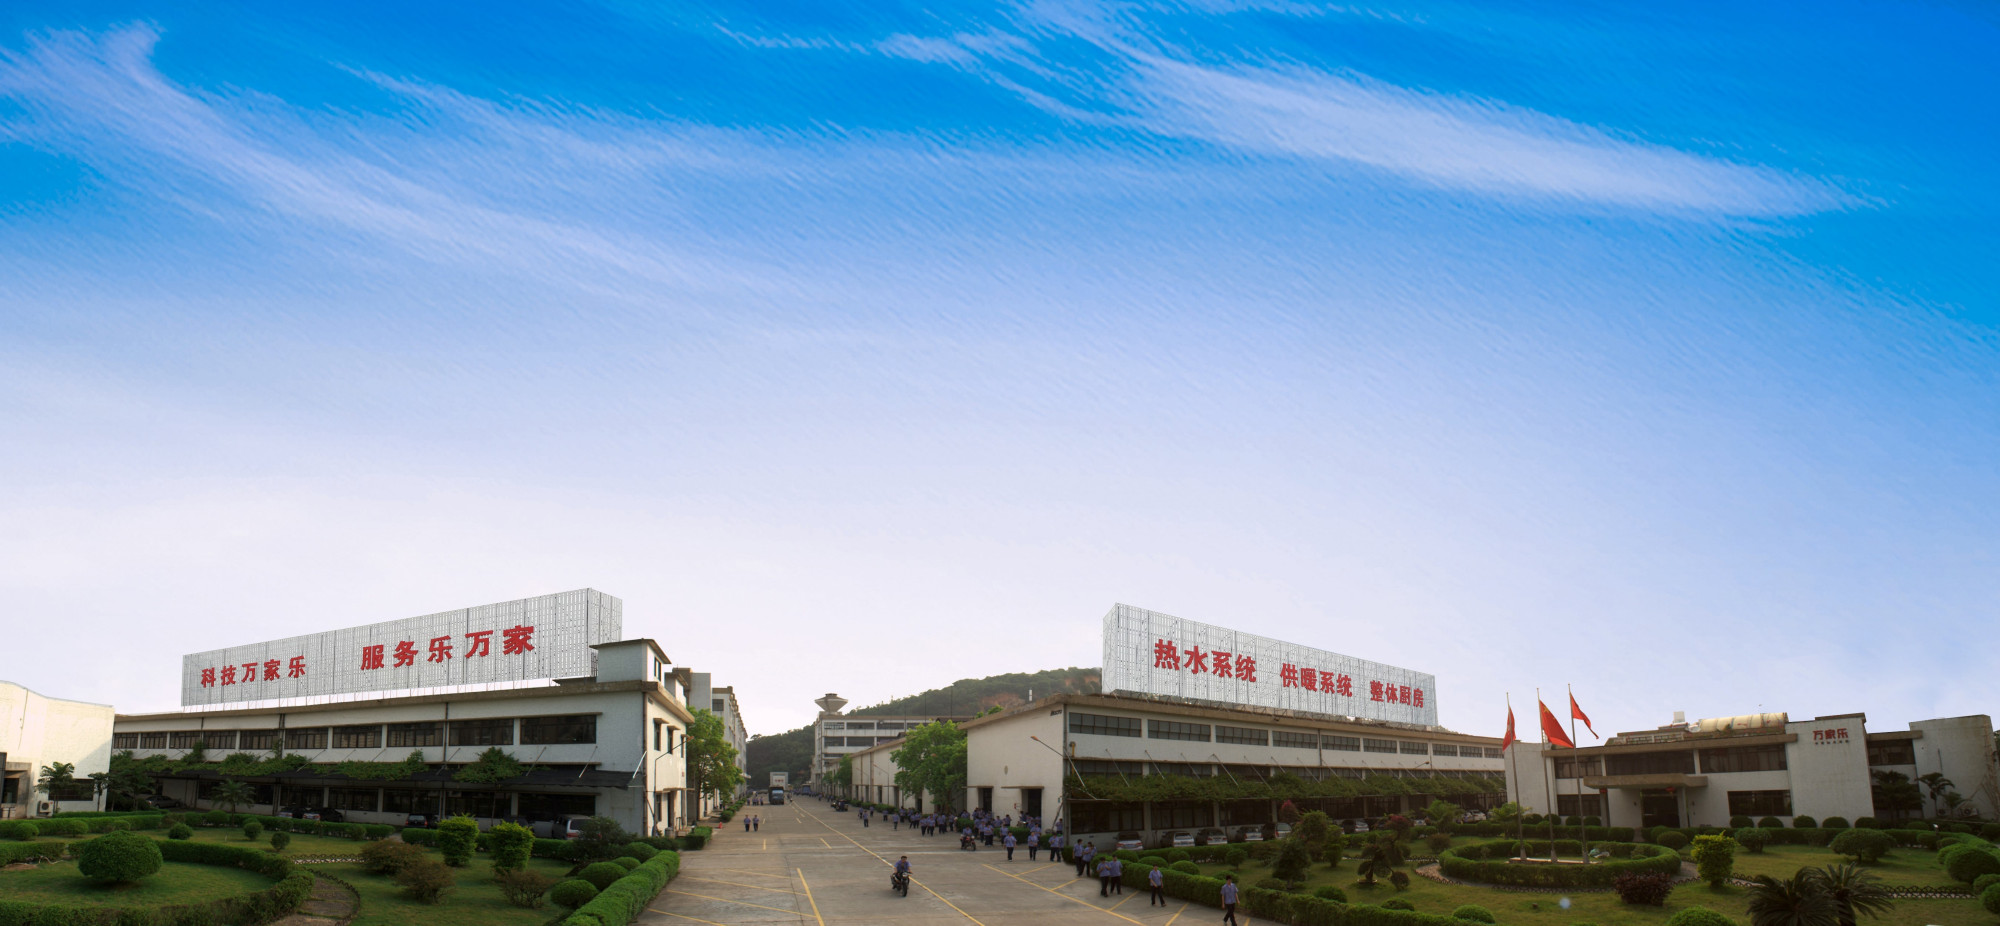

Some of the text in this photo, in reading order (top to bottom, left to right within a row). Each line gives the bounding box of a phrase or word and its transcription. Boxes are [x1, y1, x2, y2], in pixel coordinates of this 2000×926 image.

[201, 625, 535, 688] 科技万家乐 服务乐万家
[1154, 639, 1424, 708] 热水系统 供暖系统 整体厨房
[1812, 728, 1848, 740] 万家乐
